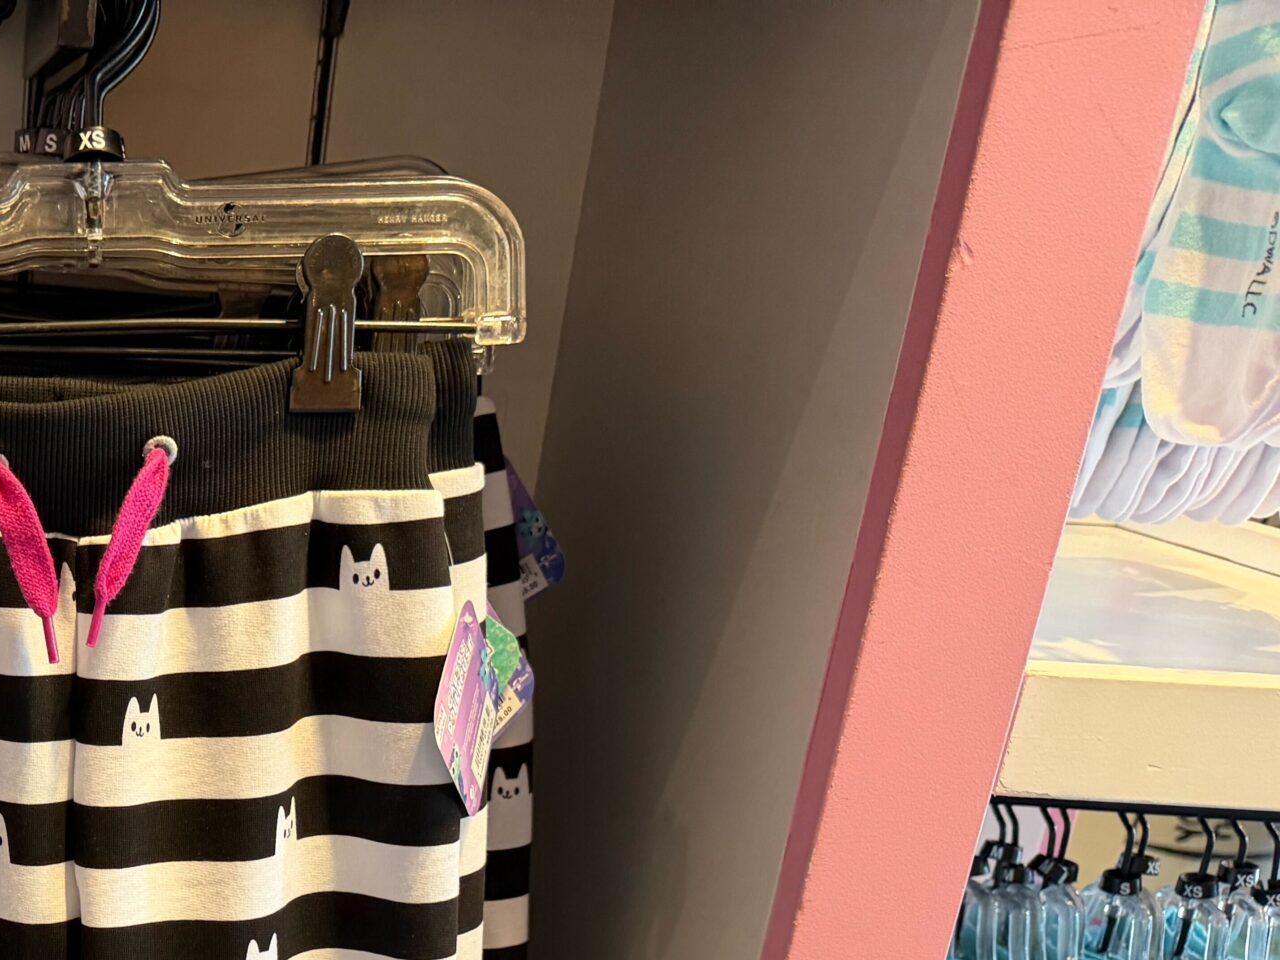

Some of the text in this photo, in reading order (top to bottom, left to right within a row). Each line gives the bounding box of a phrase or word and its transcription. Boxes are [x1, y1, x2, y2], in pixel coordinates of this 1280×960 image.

[20, 135, 30, 152] M
[45, 134, 57, 152] S
[79, 131, 105, 150] XS
[195, 214, 265, 223] UNIVERSAL
[1236, 873, 1254, 887] XS
[1120, 882, 1130, 895] S
[1183, 884, 1203, 898] XS
